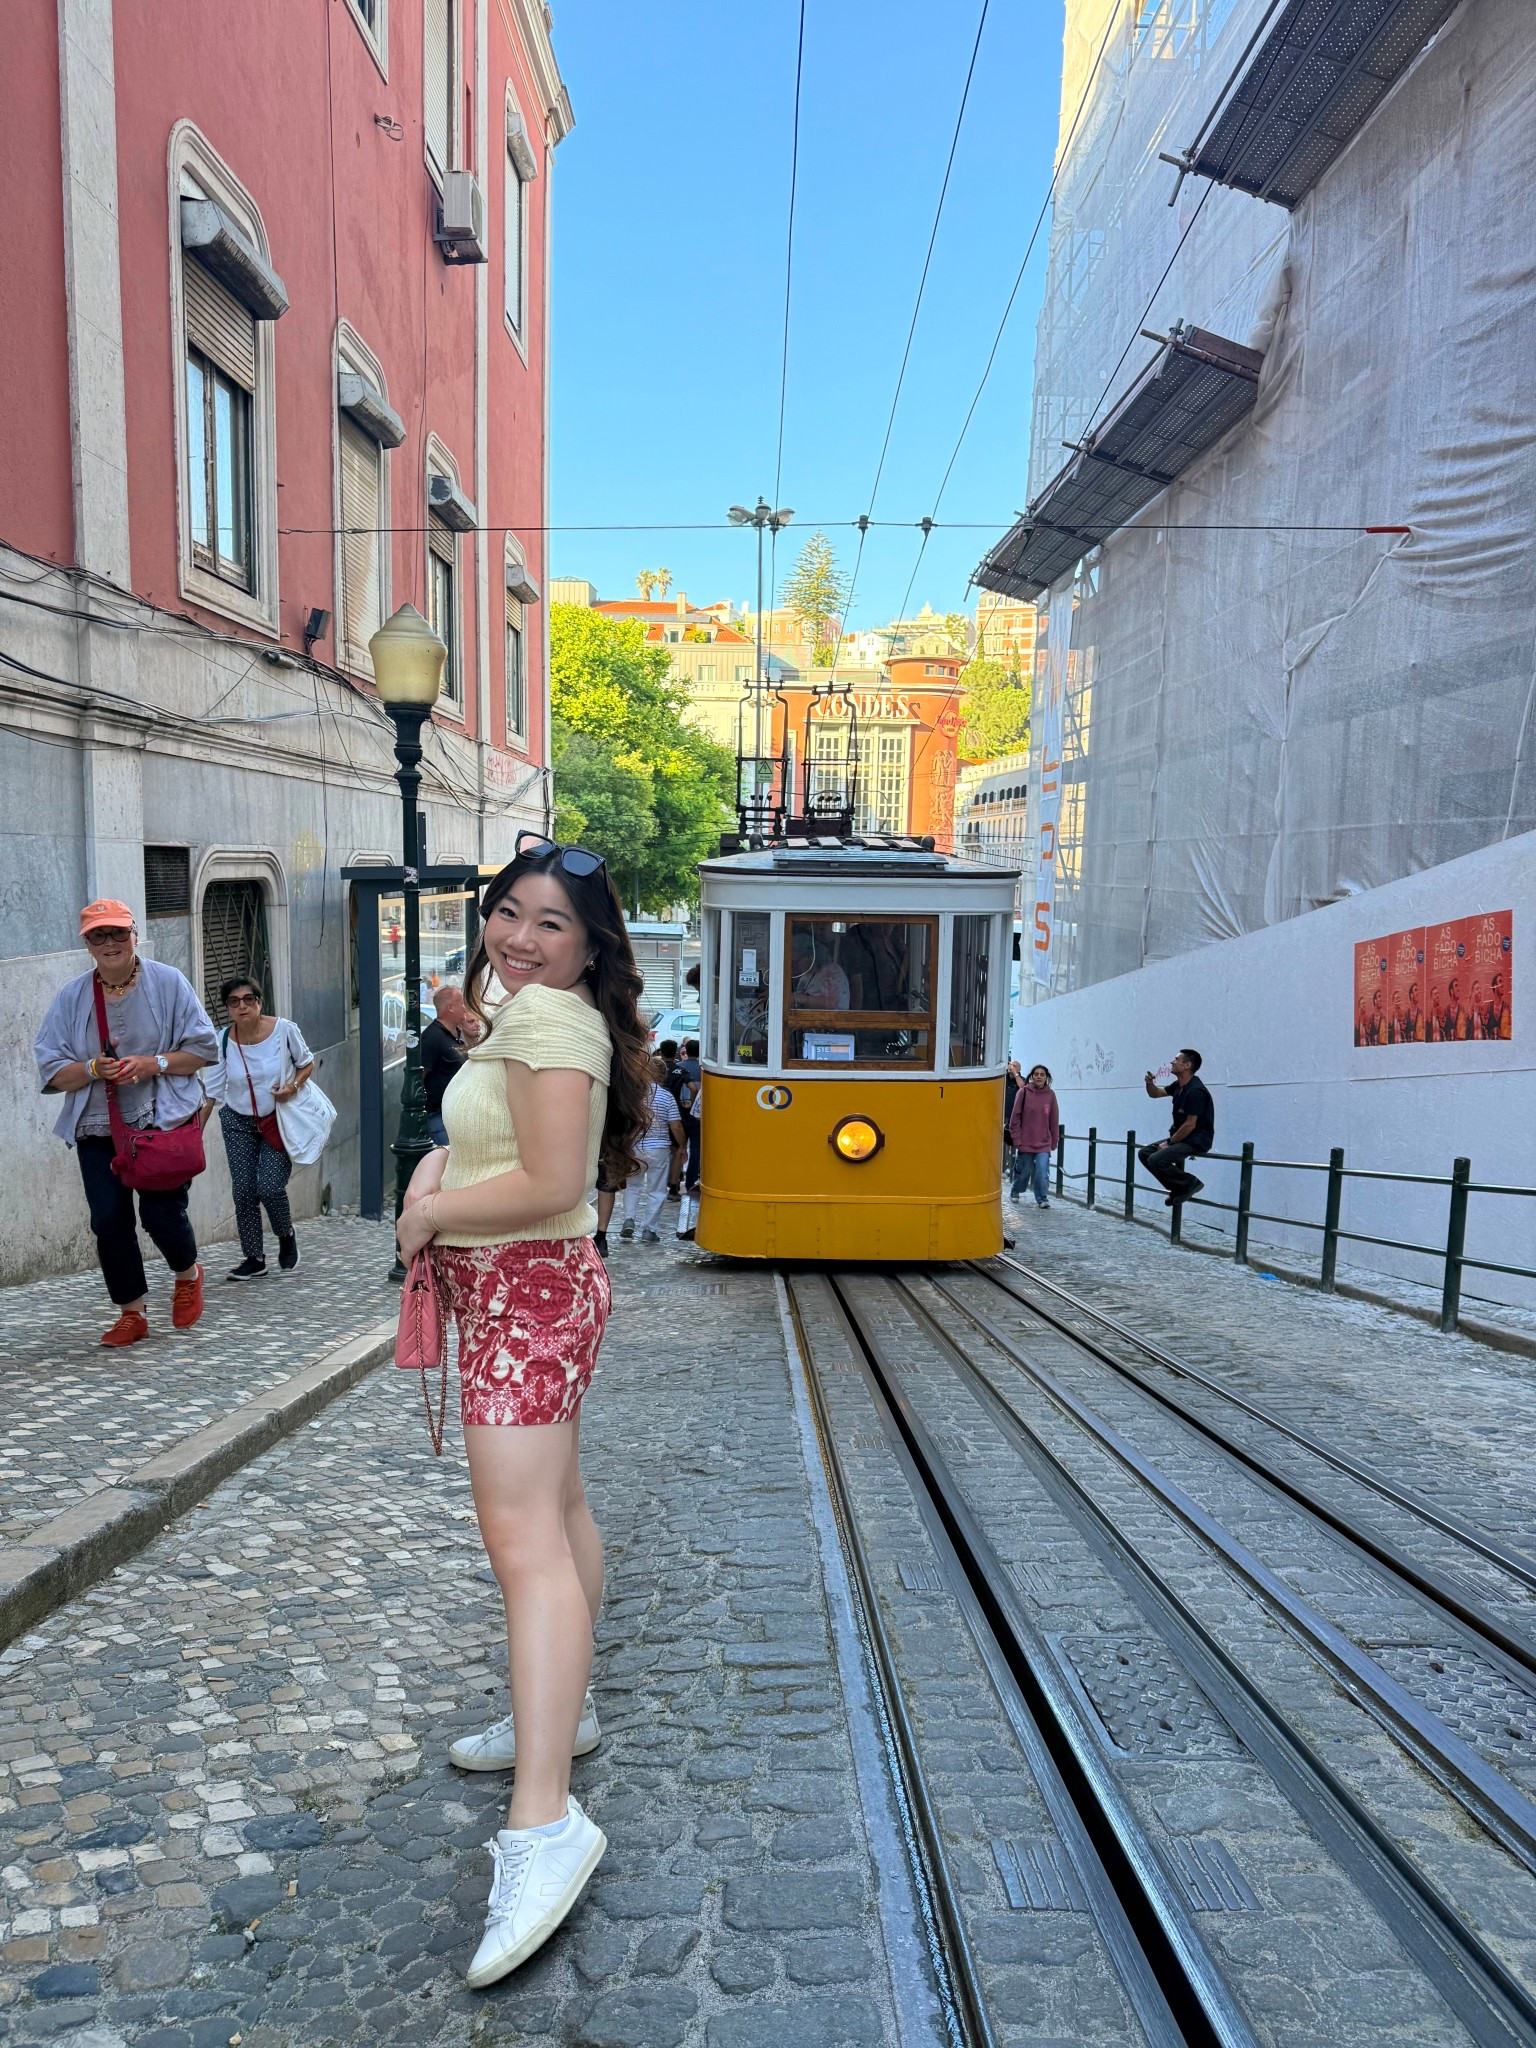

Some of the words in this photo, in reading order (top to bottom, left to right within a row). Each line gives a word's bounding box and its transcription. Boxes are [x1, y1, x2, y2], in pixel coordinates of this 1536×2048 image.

[815, 694, 909, 718] CONDES
[1482, 917, 1495, 930] AS
[1402, 934, 1412, 946] AS
[1440, 926, 1452, 940] AS
[1476, 932, 1501, 947] FADO
[1396, 946, 1416, 962] FADO
[1435, 940, 1456, 954] FADO
[1433, 954, 1459, 970] BICHA
[1475, 949, 1503, 963] BICHA
[939, 1087, 944, 1098] 1
